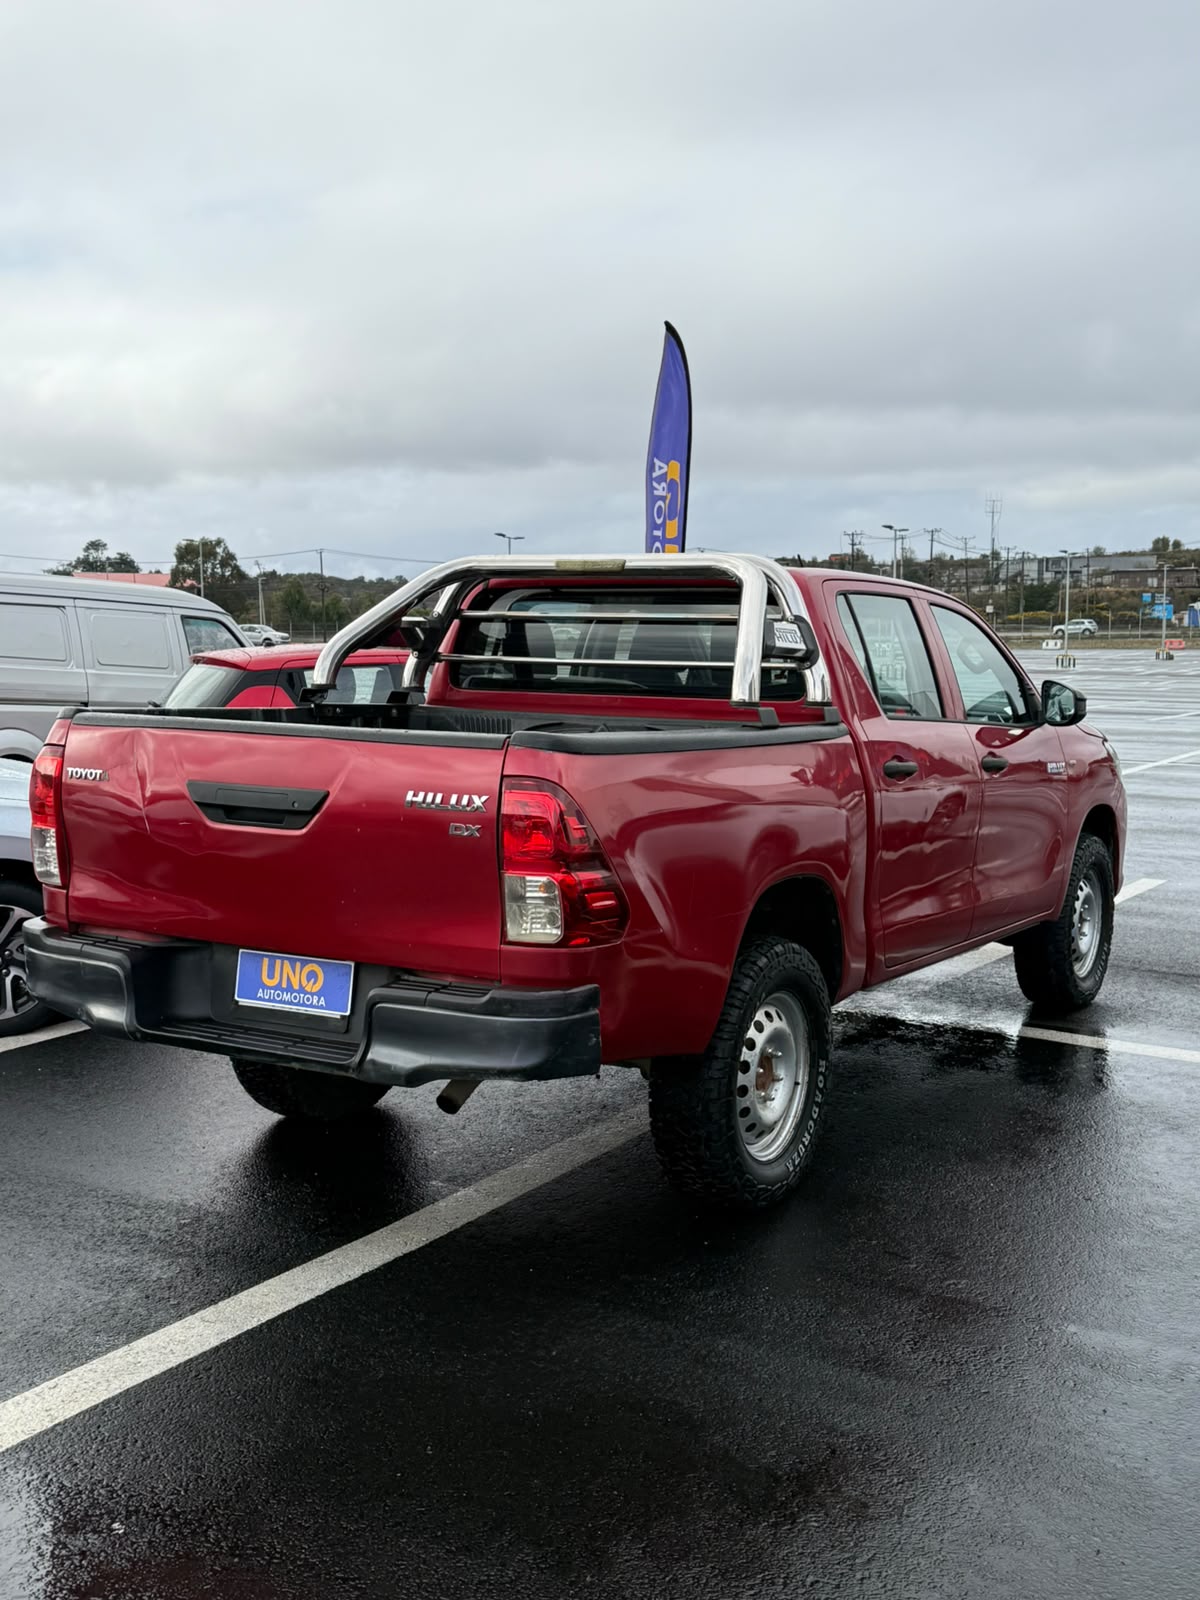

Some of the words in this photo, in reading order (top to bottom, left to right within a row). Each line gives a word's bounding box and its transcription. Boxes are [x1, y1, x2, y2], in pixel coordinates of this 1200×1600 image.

[66, 767, 110, 782] TOYOTA
[405, 790, 489, 812] HILUX
[449, 822, 481, 837] DX
[261, 957, 325, 993] UNO
[257, 987, 326, 1007] AUTOMOTORA
